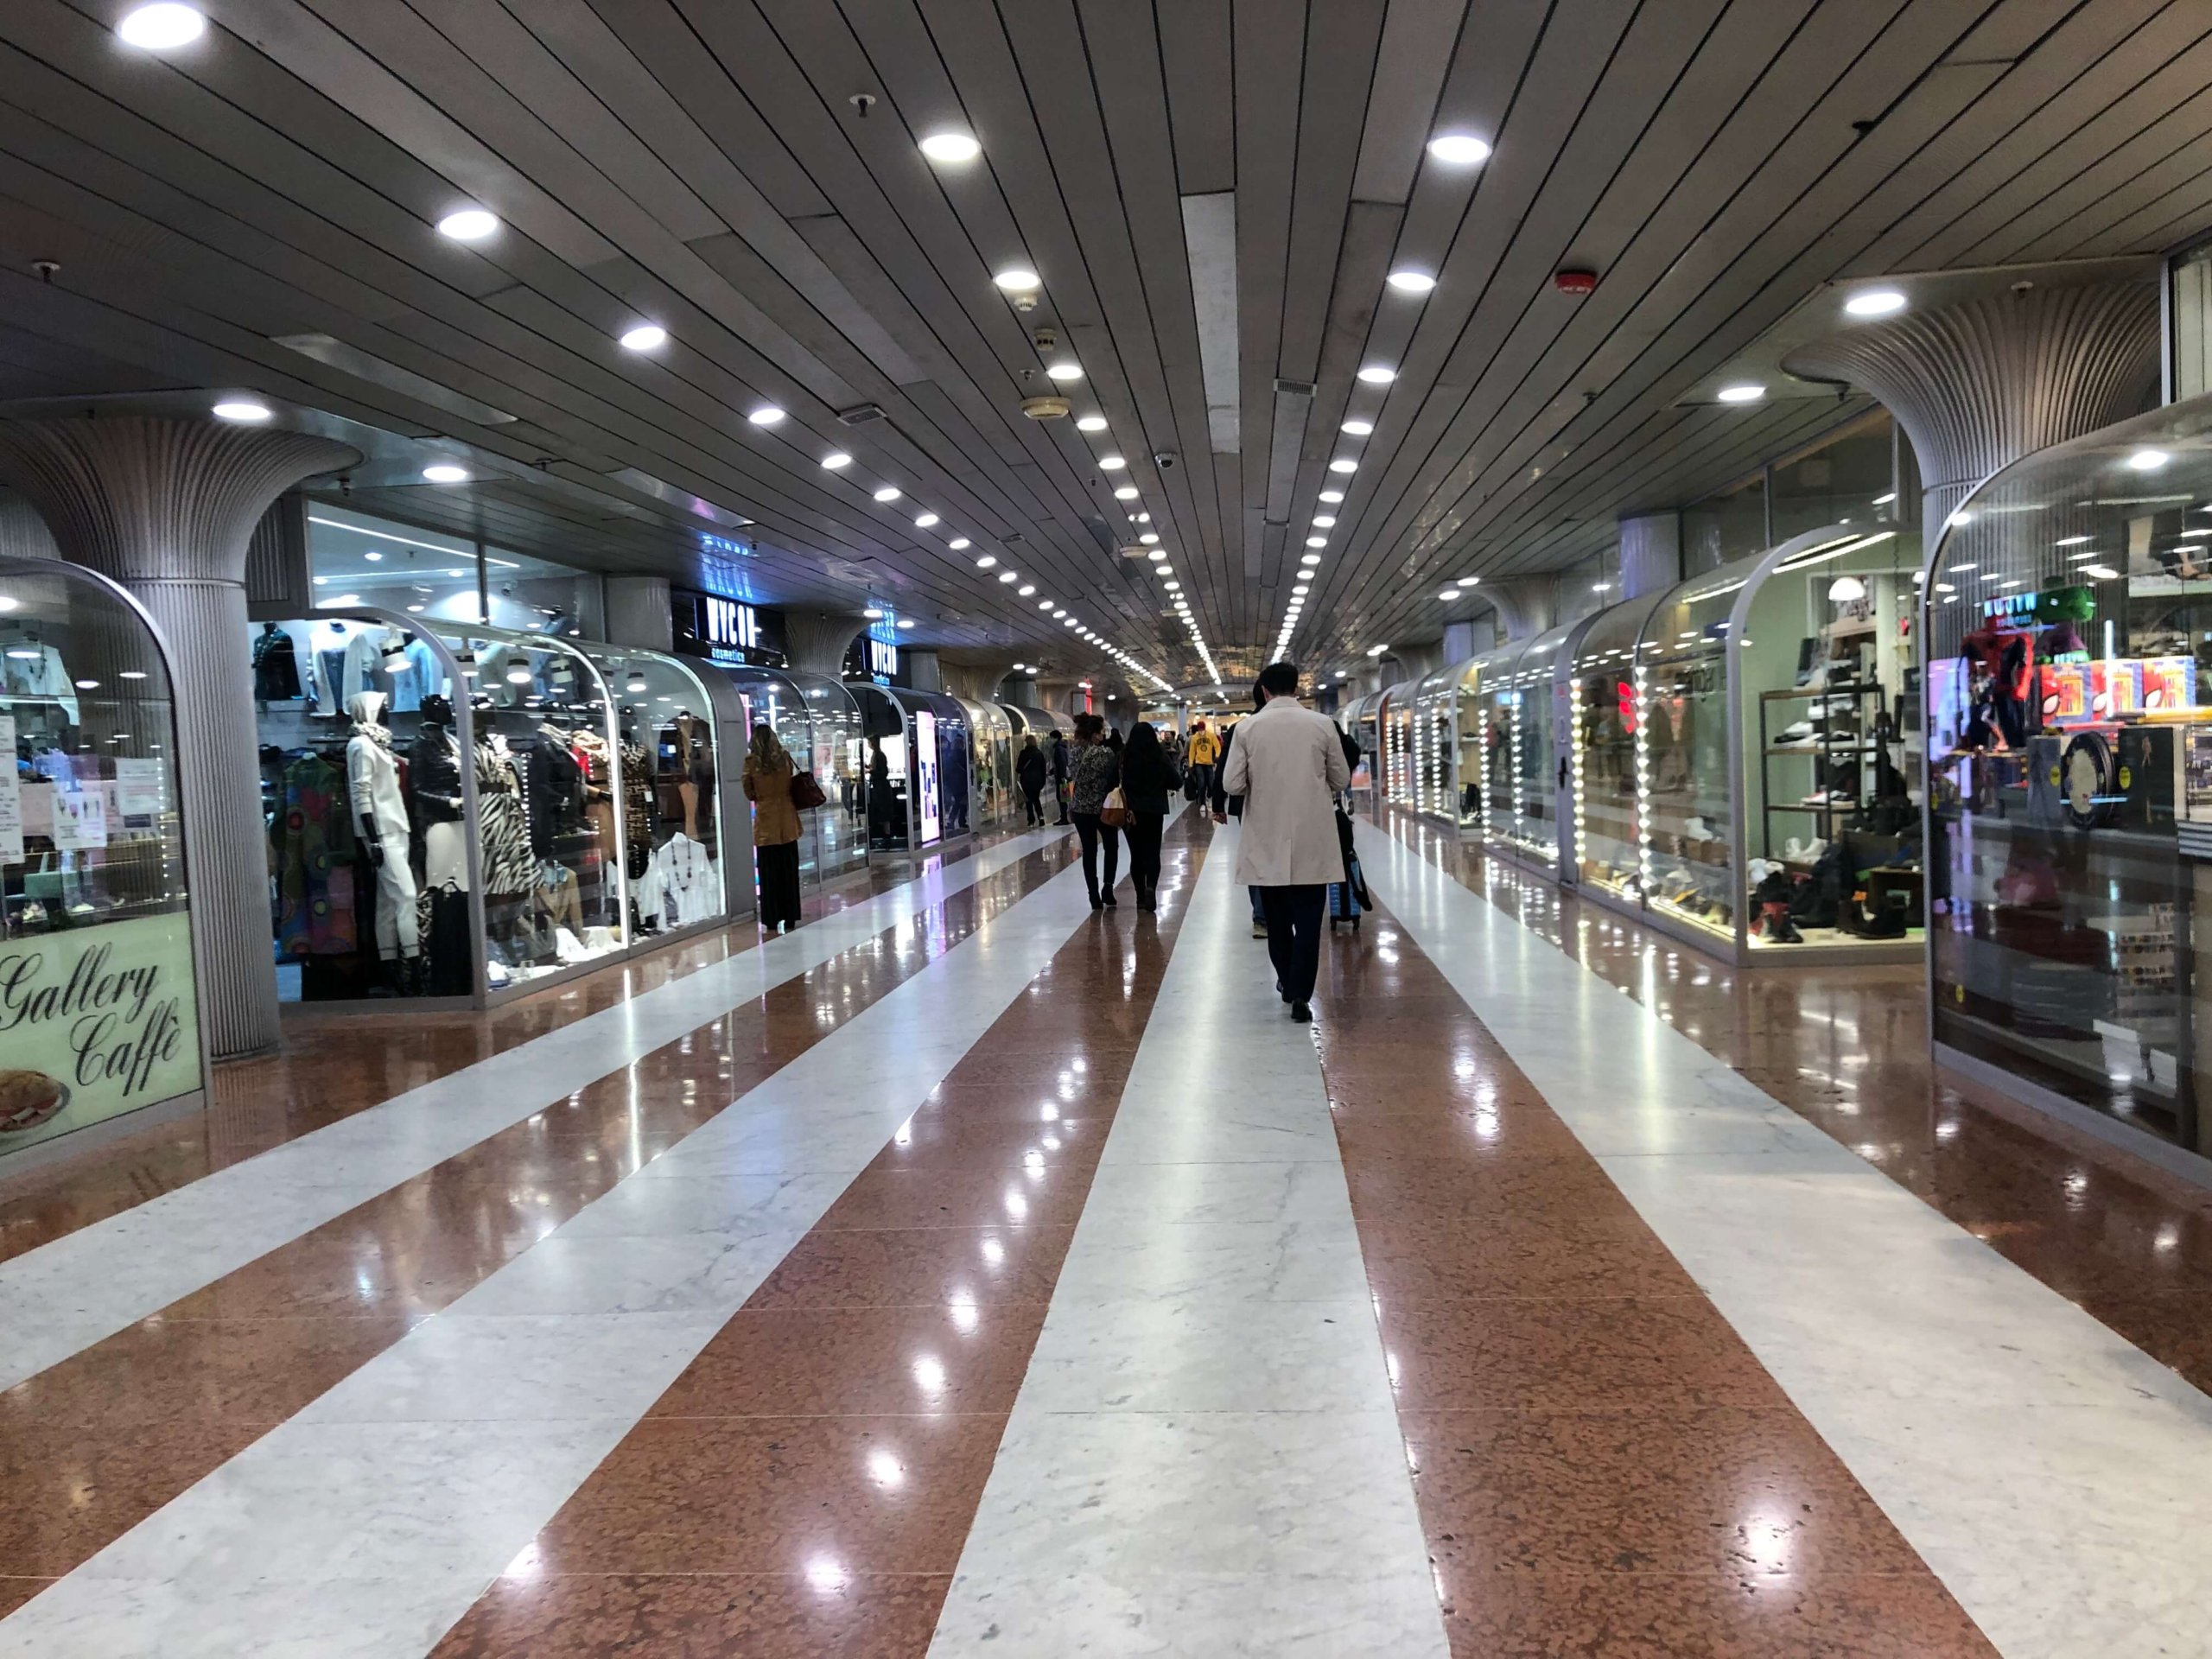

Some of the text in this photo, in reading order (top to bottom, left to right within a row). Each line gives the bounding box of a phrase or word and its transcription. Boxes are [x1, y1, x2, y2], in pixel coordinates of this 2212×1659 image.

[706, 596, 756, 648] WYCON
[711, 647, 745, 663] cosmetics
[871, 639, 897, 676] WYCON
[0, 941, 159, 1031] Gallery
[69, 996, 181, 1096] Caffè
